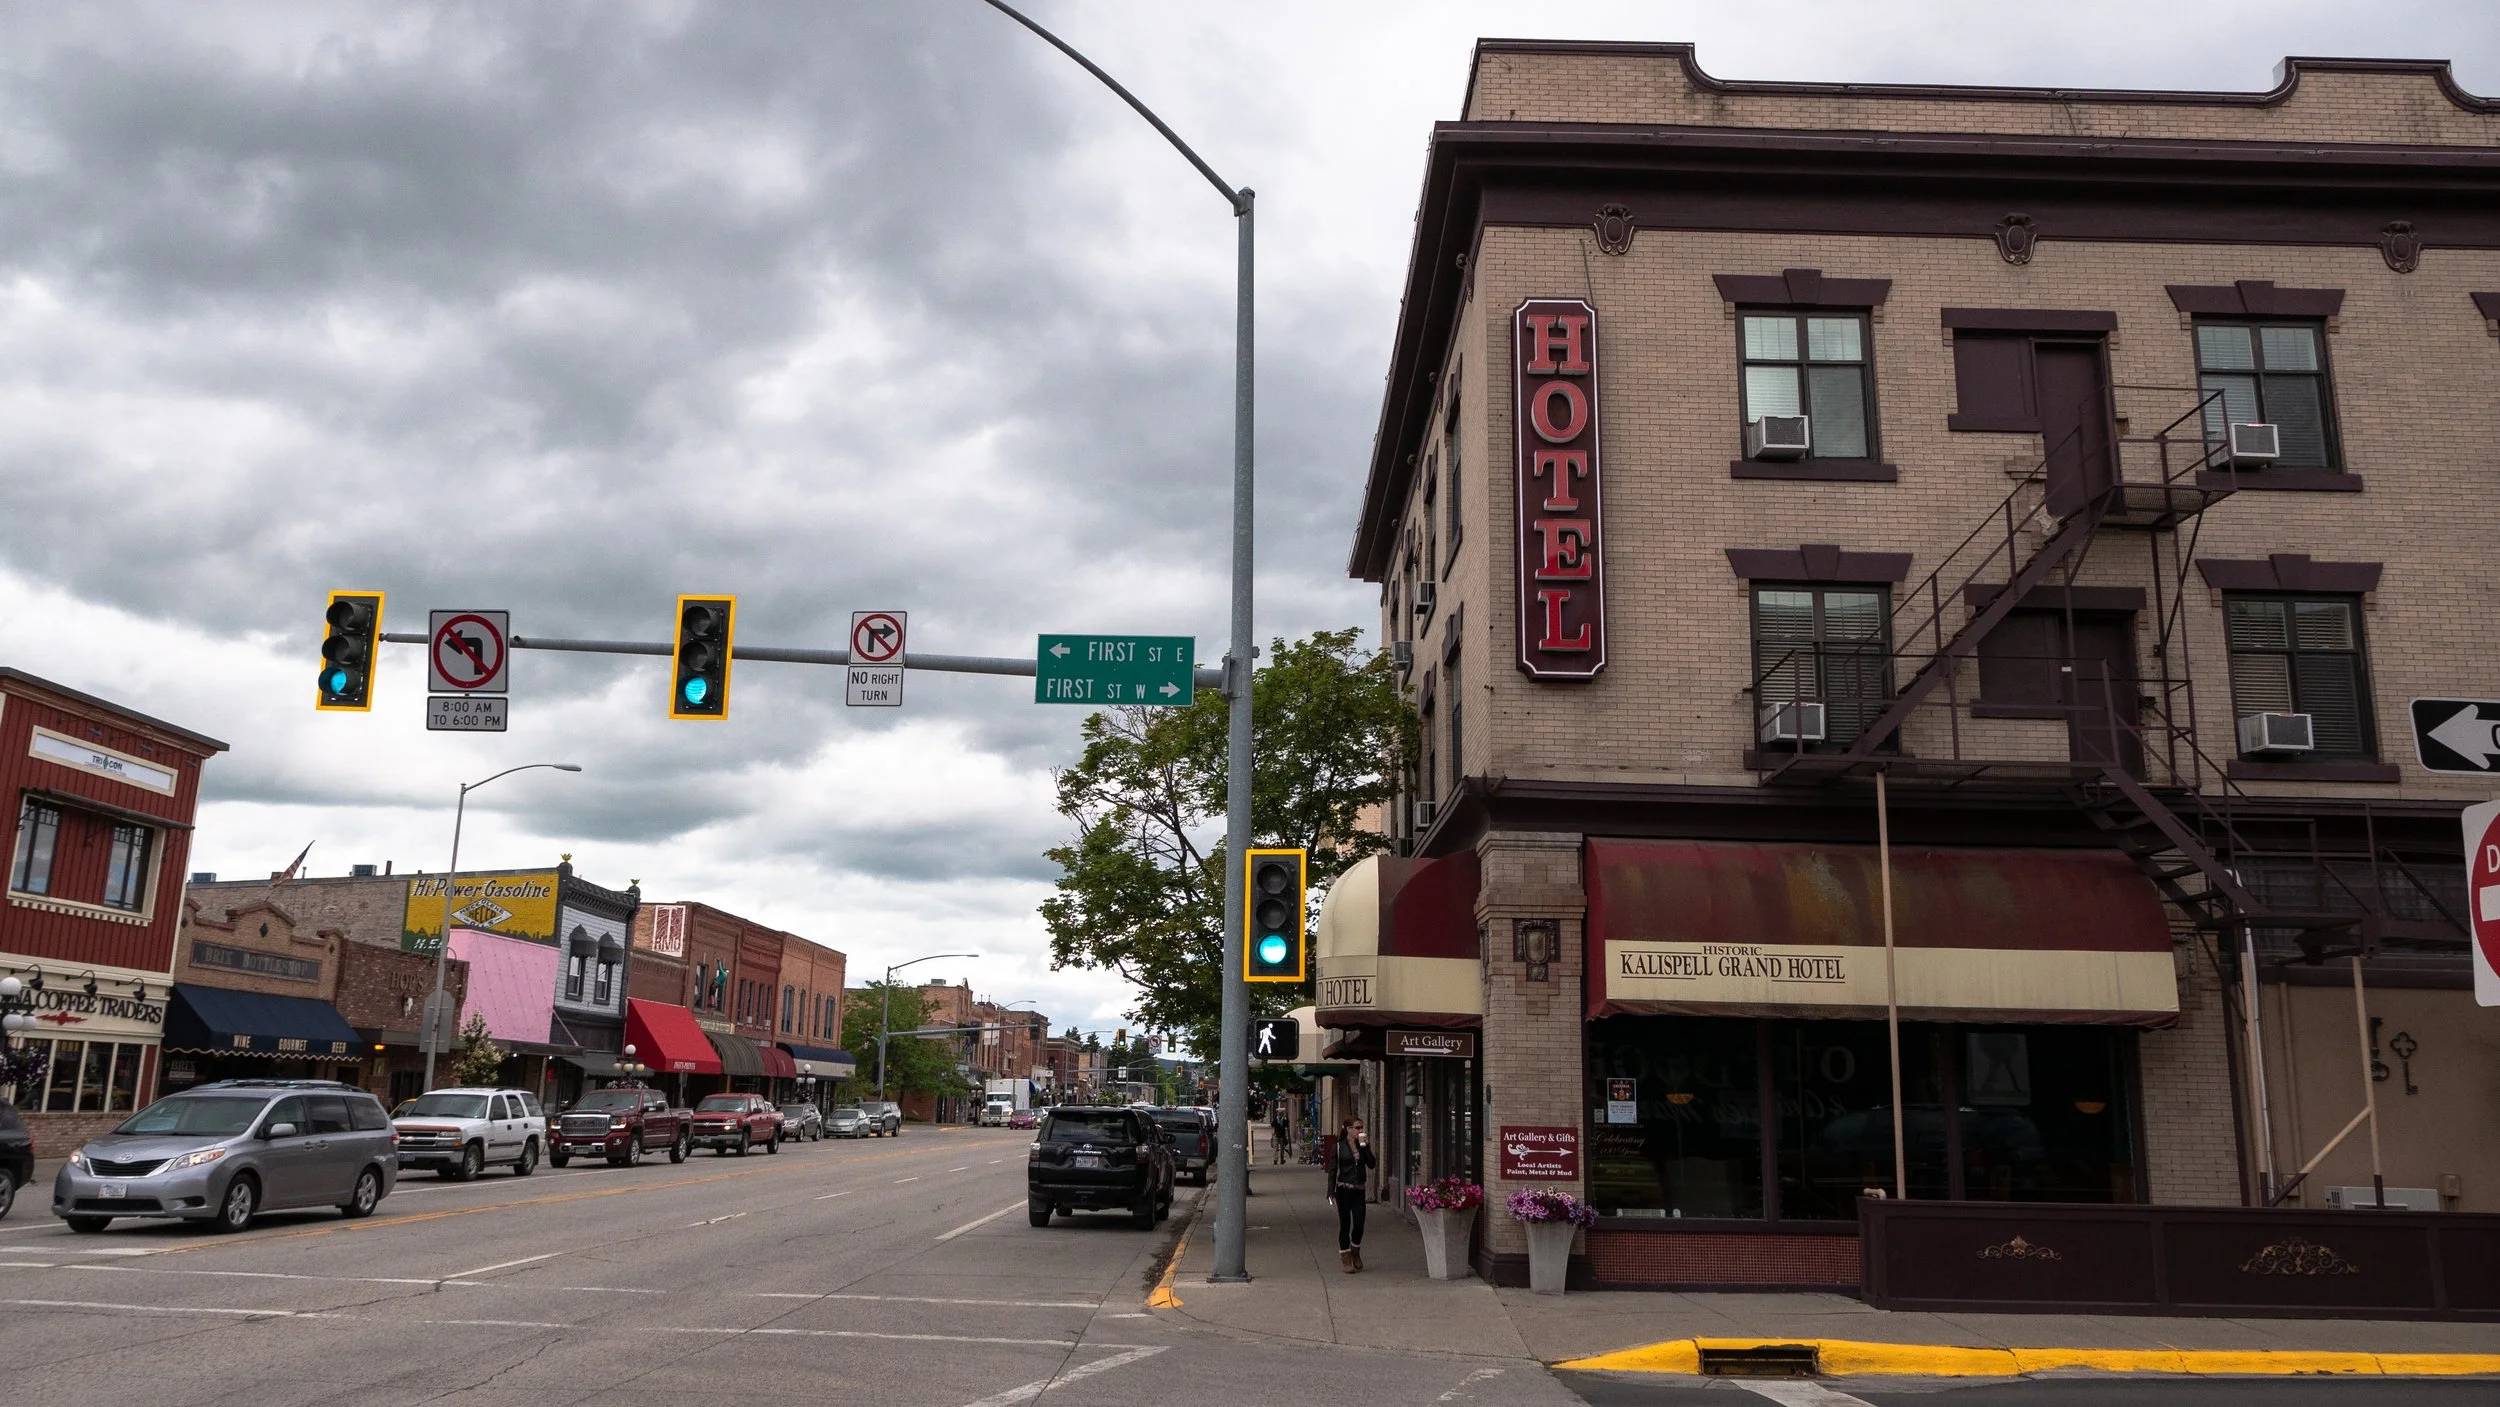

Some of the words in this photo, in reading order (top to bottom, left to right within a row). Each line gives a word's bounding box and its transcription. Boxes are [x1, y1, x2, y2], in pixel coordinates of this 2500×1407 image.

[1526, 315, 1591, 652] HOTEL
[1088, 642, 1136, 662] FIRST
[1149, 647, 1163, 662] ST
[1177, 648, 1184, 662] E
[851, 672, 868, 684] NO
[871, 674, 900, 684] RIGHT
[861, 690, 888, 700] TURN
[1047, 679, 1094, 699] FIRST
[1107, 684, 1122, 699] ST
[1136, 684, 1146, 699] W
[442, 702, 469, 713] 8:00
[475, 703, 492, 713] AM
[433, 715, 447, 726] TO
[453, 715, 479, 726] 6:00
[485, 716, 501, 726] PM
[109, 760, 123, 770] CON
[484, 880, 551, 898] Gasoline
[205, 946, 234, 965] BRIX
[1702, 945, 1763, 957] HISTORIC
[1620, 953, 1713, 976] KALISPELL
[1718, 956, 1782, 978] GRAND
[1788, 958, 1846, 980] HOTEL
[1325, 978, 1373, 1006] HOTEL
[36, 990, 98, 1013] COFFEE
[100, 996, 163, 1024] TRADERS
[233, 1034, 251, 1048] WINE
[278, 1038, 308, 1051] GOURMET
[331, 1041, 347, 1053] BEER
[1400, 1035, 1419, 1047] Art
[1421, 1036, 1463, 1051] Gallery
[1503, 1132, 1517, 1141] Art
[1518, 1132, 1547, 1143] Gallery
[1548, 1133, 1555, 1142] &
[1556, 1133, 1575, 1142] Gifts
